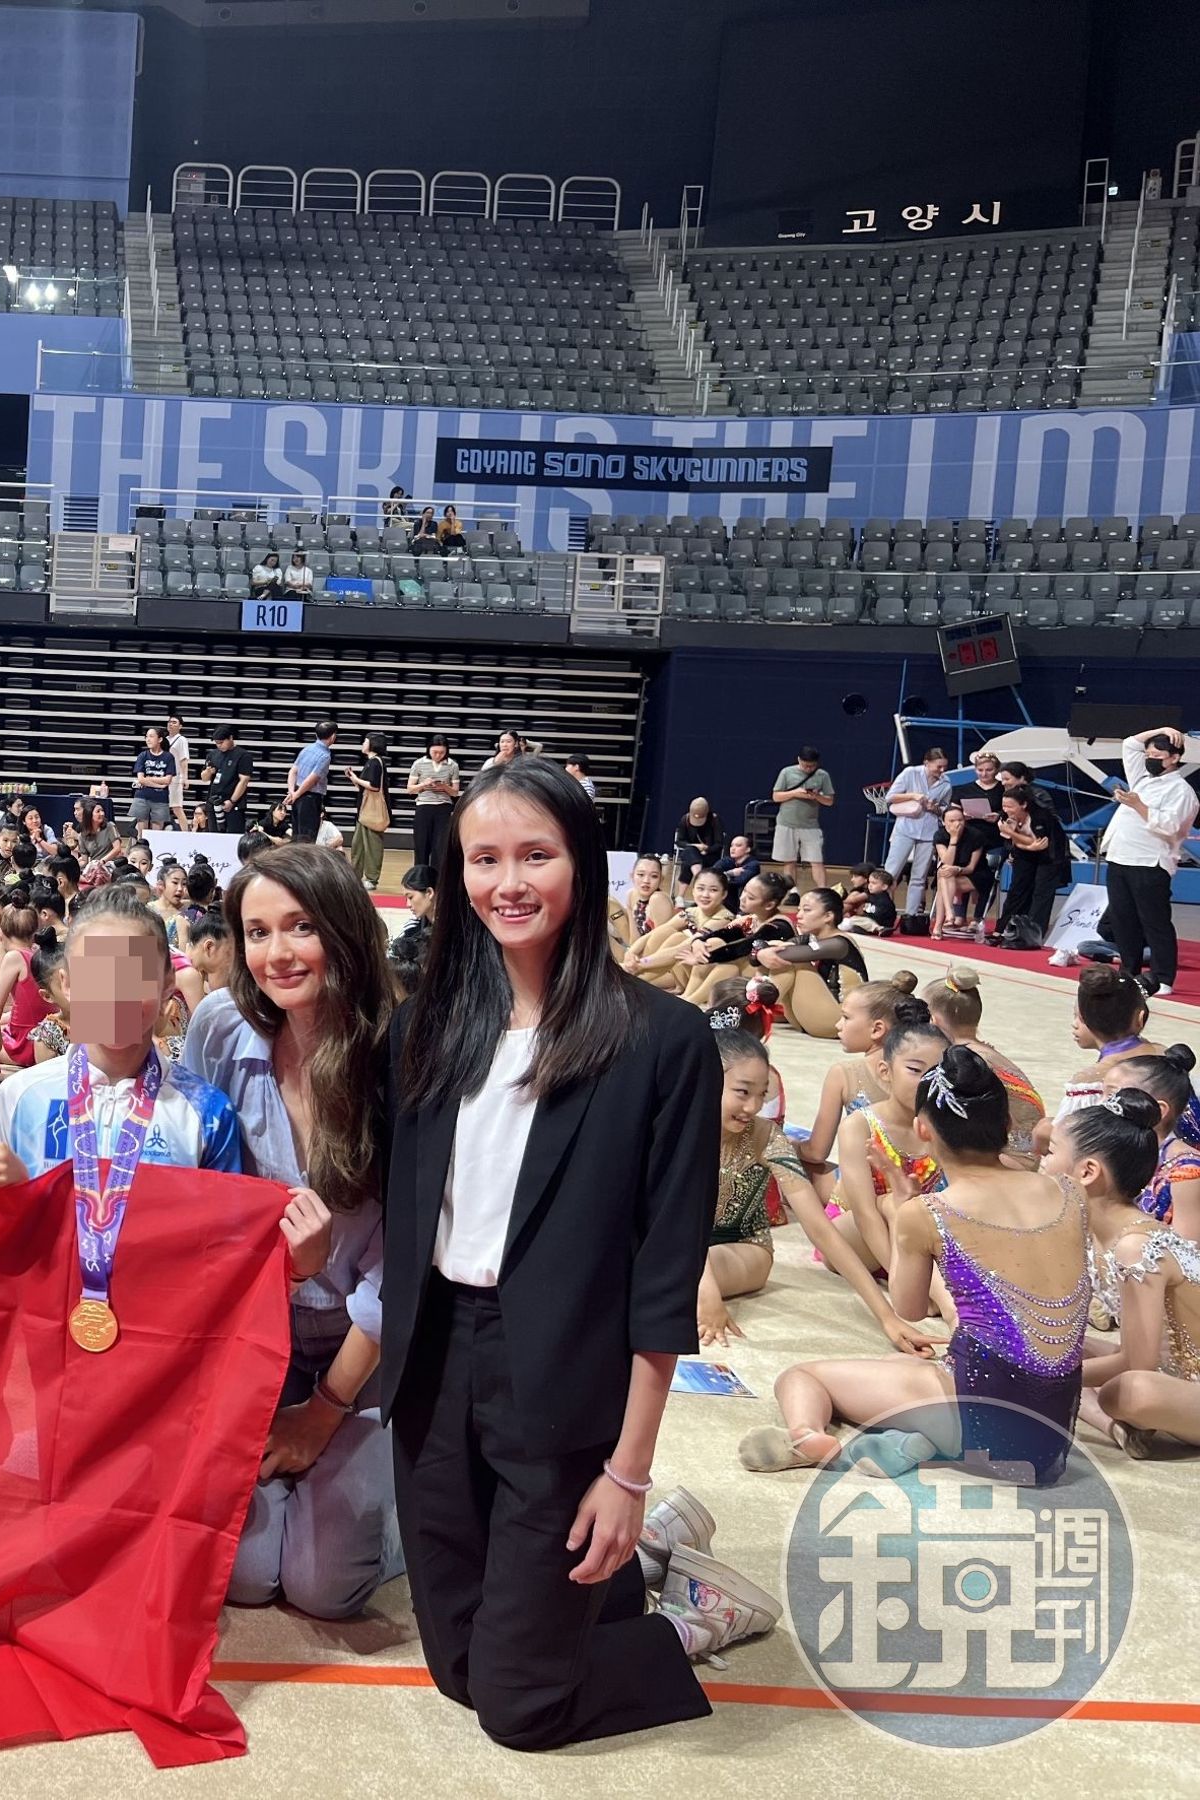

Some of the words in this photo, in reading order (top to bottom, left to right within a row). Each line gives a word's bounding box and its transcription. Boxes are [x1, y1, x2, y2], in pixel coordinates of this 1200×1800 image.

[33, 394, 231, 534] THE
[456, 448, 536, 476] GOYANG
[543, 452, 625, 479] SONO
[632, 455, 808, 483] SKYGUNNERS
[256, 604, 288, 627] R10
